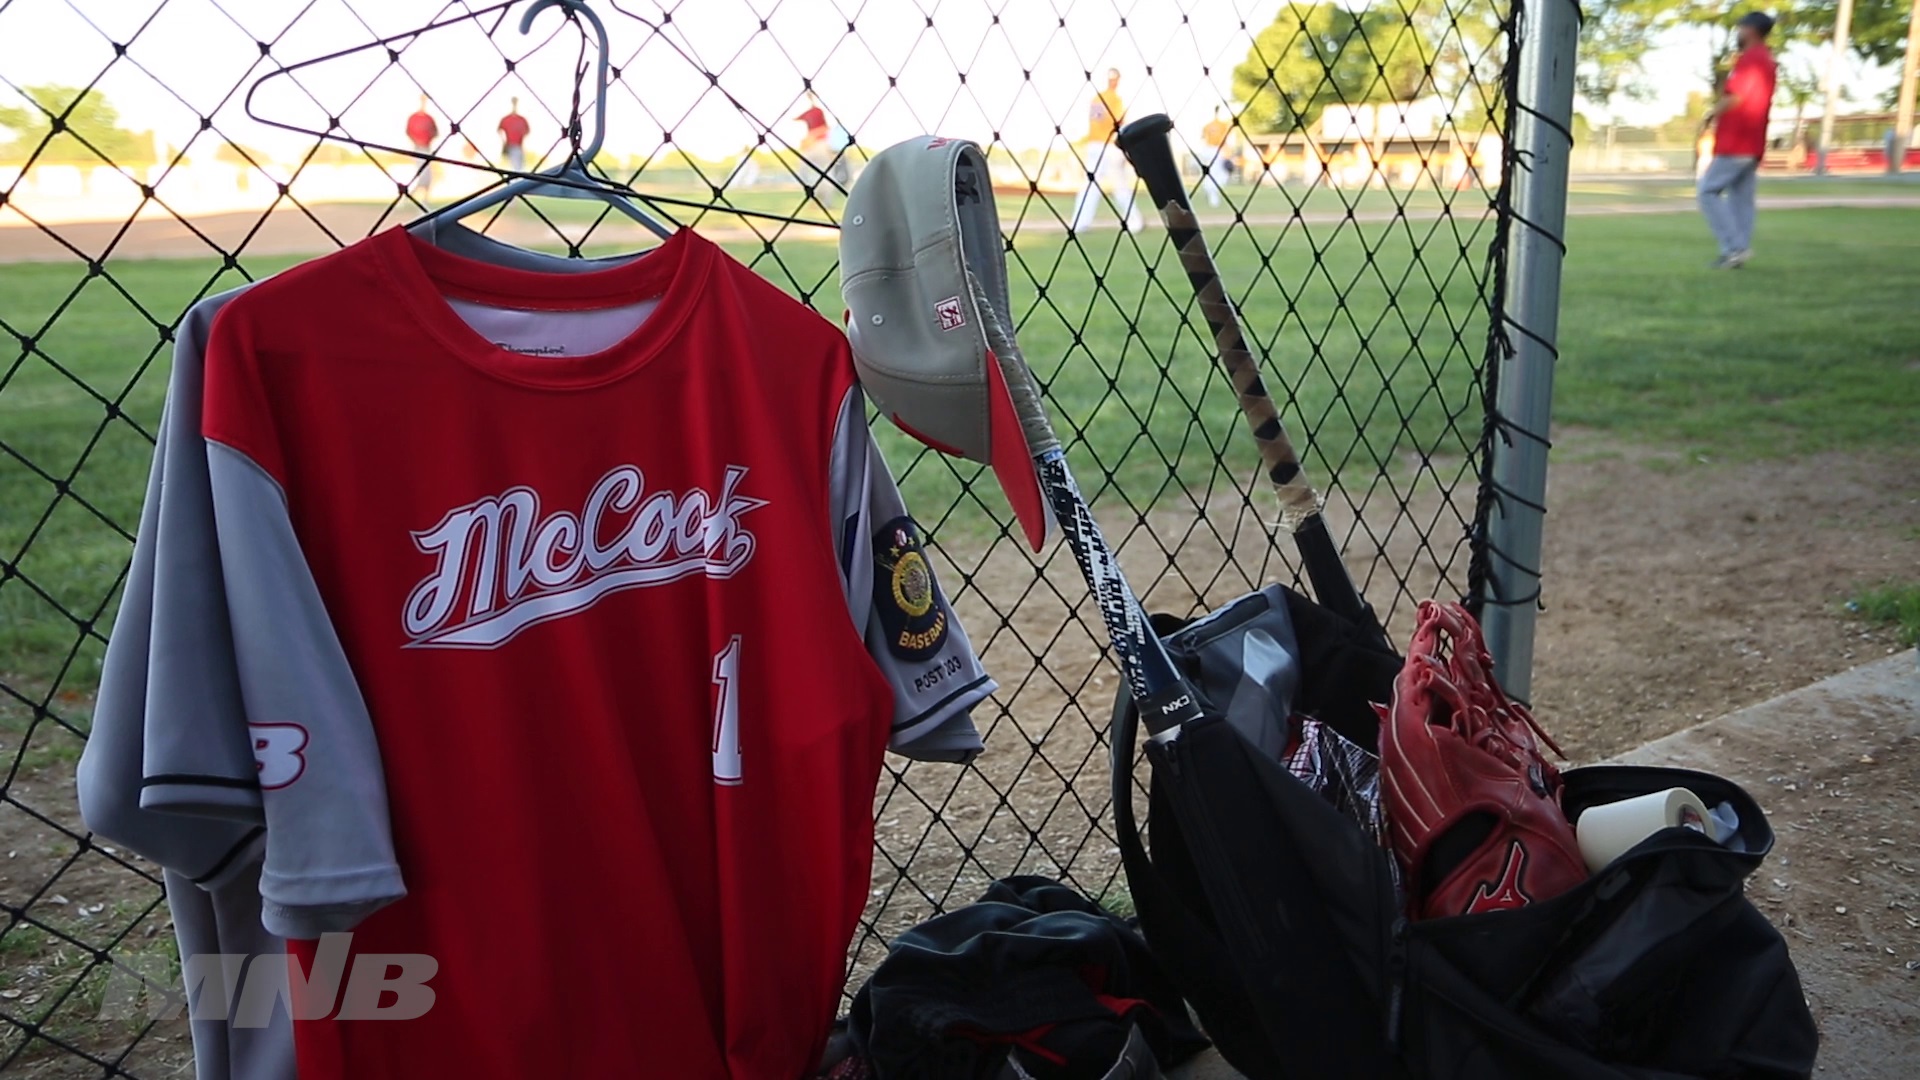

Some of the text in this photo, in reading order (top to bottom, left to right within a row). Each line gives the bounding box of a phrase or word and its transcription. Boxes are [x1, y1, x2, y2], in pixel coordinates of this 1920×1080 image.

[401, 464, 770, 642] McCook
[898, 611, 945, 650] BASEBALL
[711, 634, 743, 786] 1
[914, 665, 945, 693] POST
